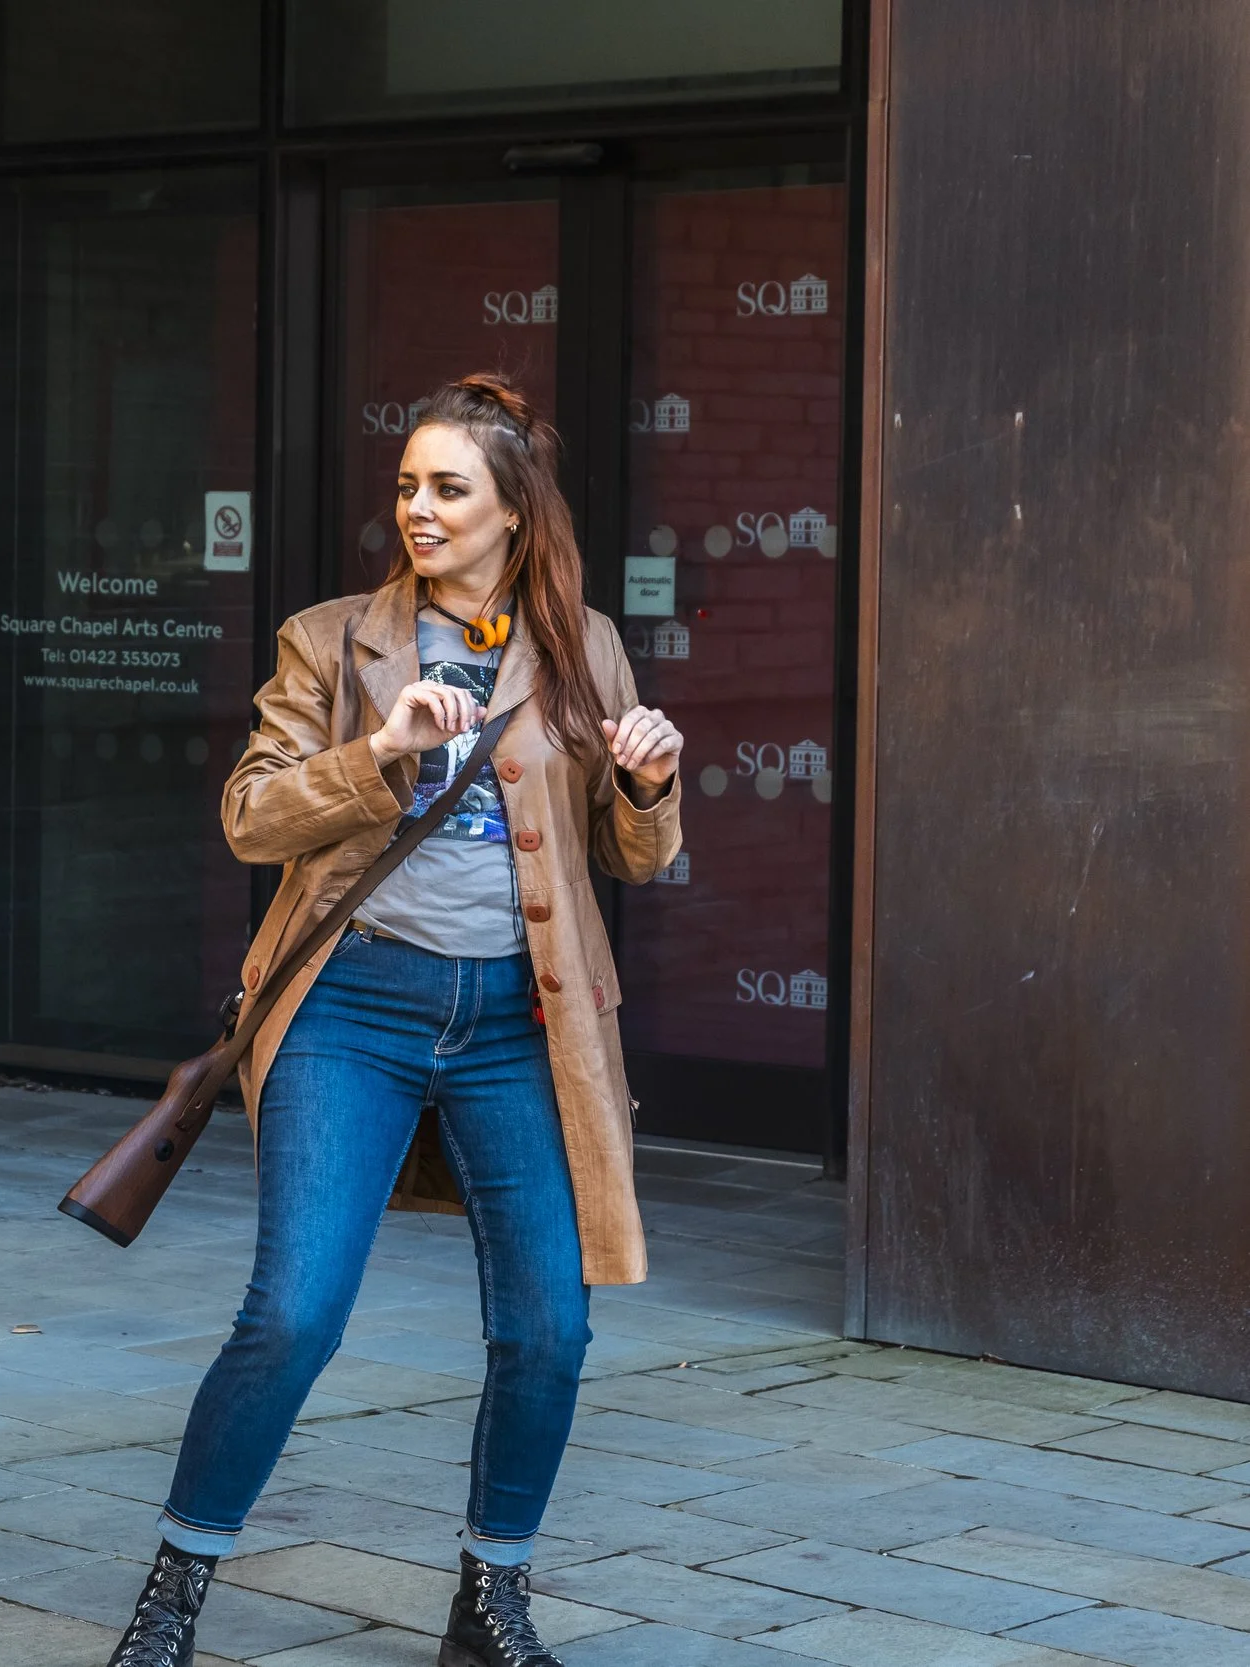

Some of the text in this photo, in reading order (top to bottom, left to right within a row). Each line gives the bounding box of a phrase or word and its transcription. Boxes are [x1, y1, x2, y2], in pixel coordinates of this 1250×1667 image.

[483, 291, 529, 325] SQ
[736, 280, 788, 317] SQ
[362, 402, 406, 435] SQ
[629, 398, 653, 432] Q
[57, 570, 158, 594] Welcome
[628, 575, 672, 585] Automatic
[640, 588, 660, 597] door
[0, 615, 223, 639] Square Chapel Arts Centre
[626, 622, 650, 658] Q
[41, 648, 180, 666] Tel: 01422 353073
[24, 675, 199, 694] www.squarechapel.co.uk
[736, 968, 788, 1005] SQ
